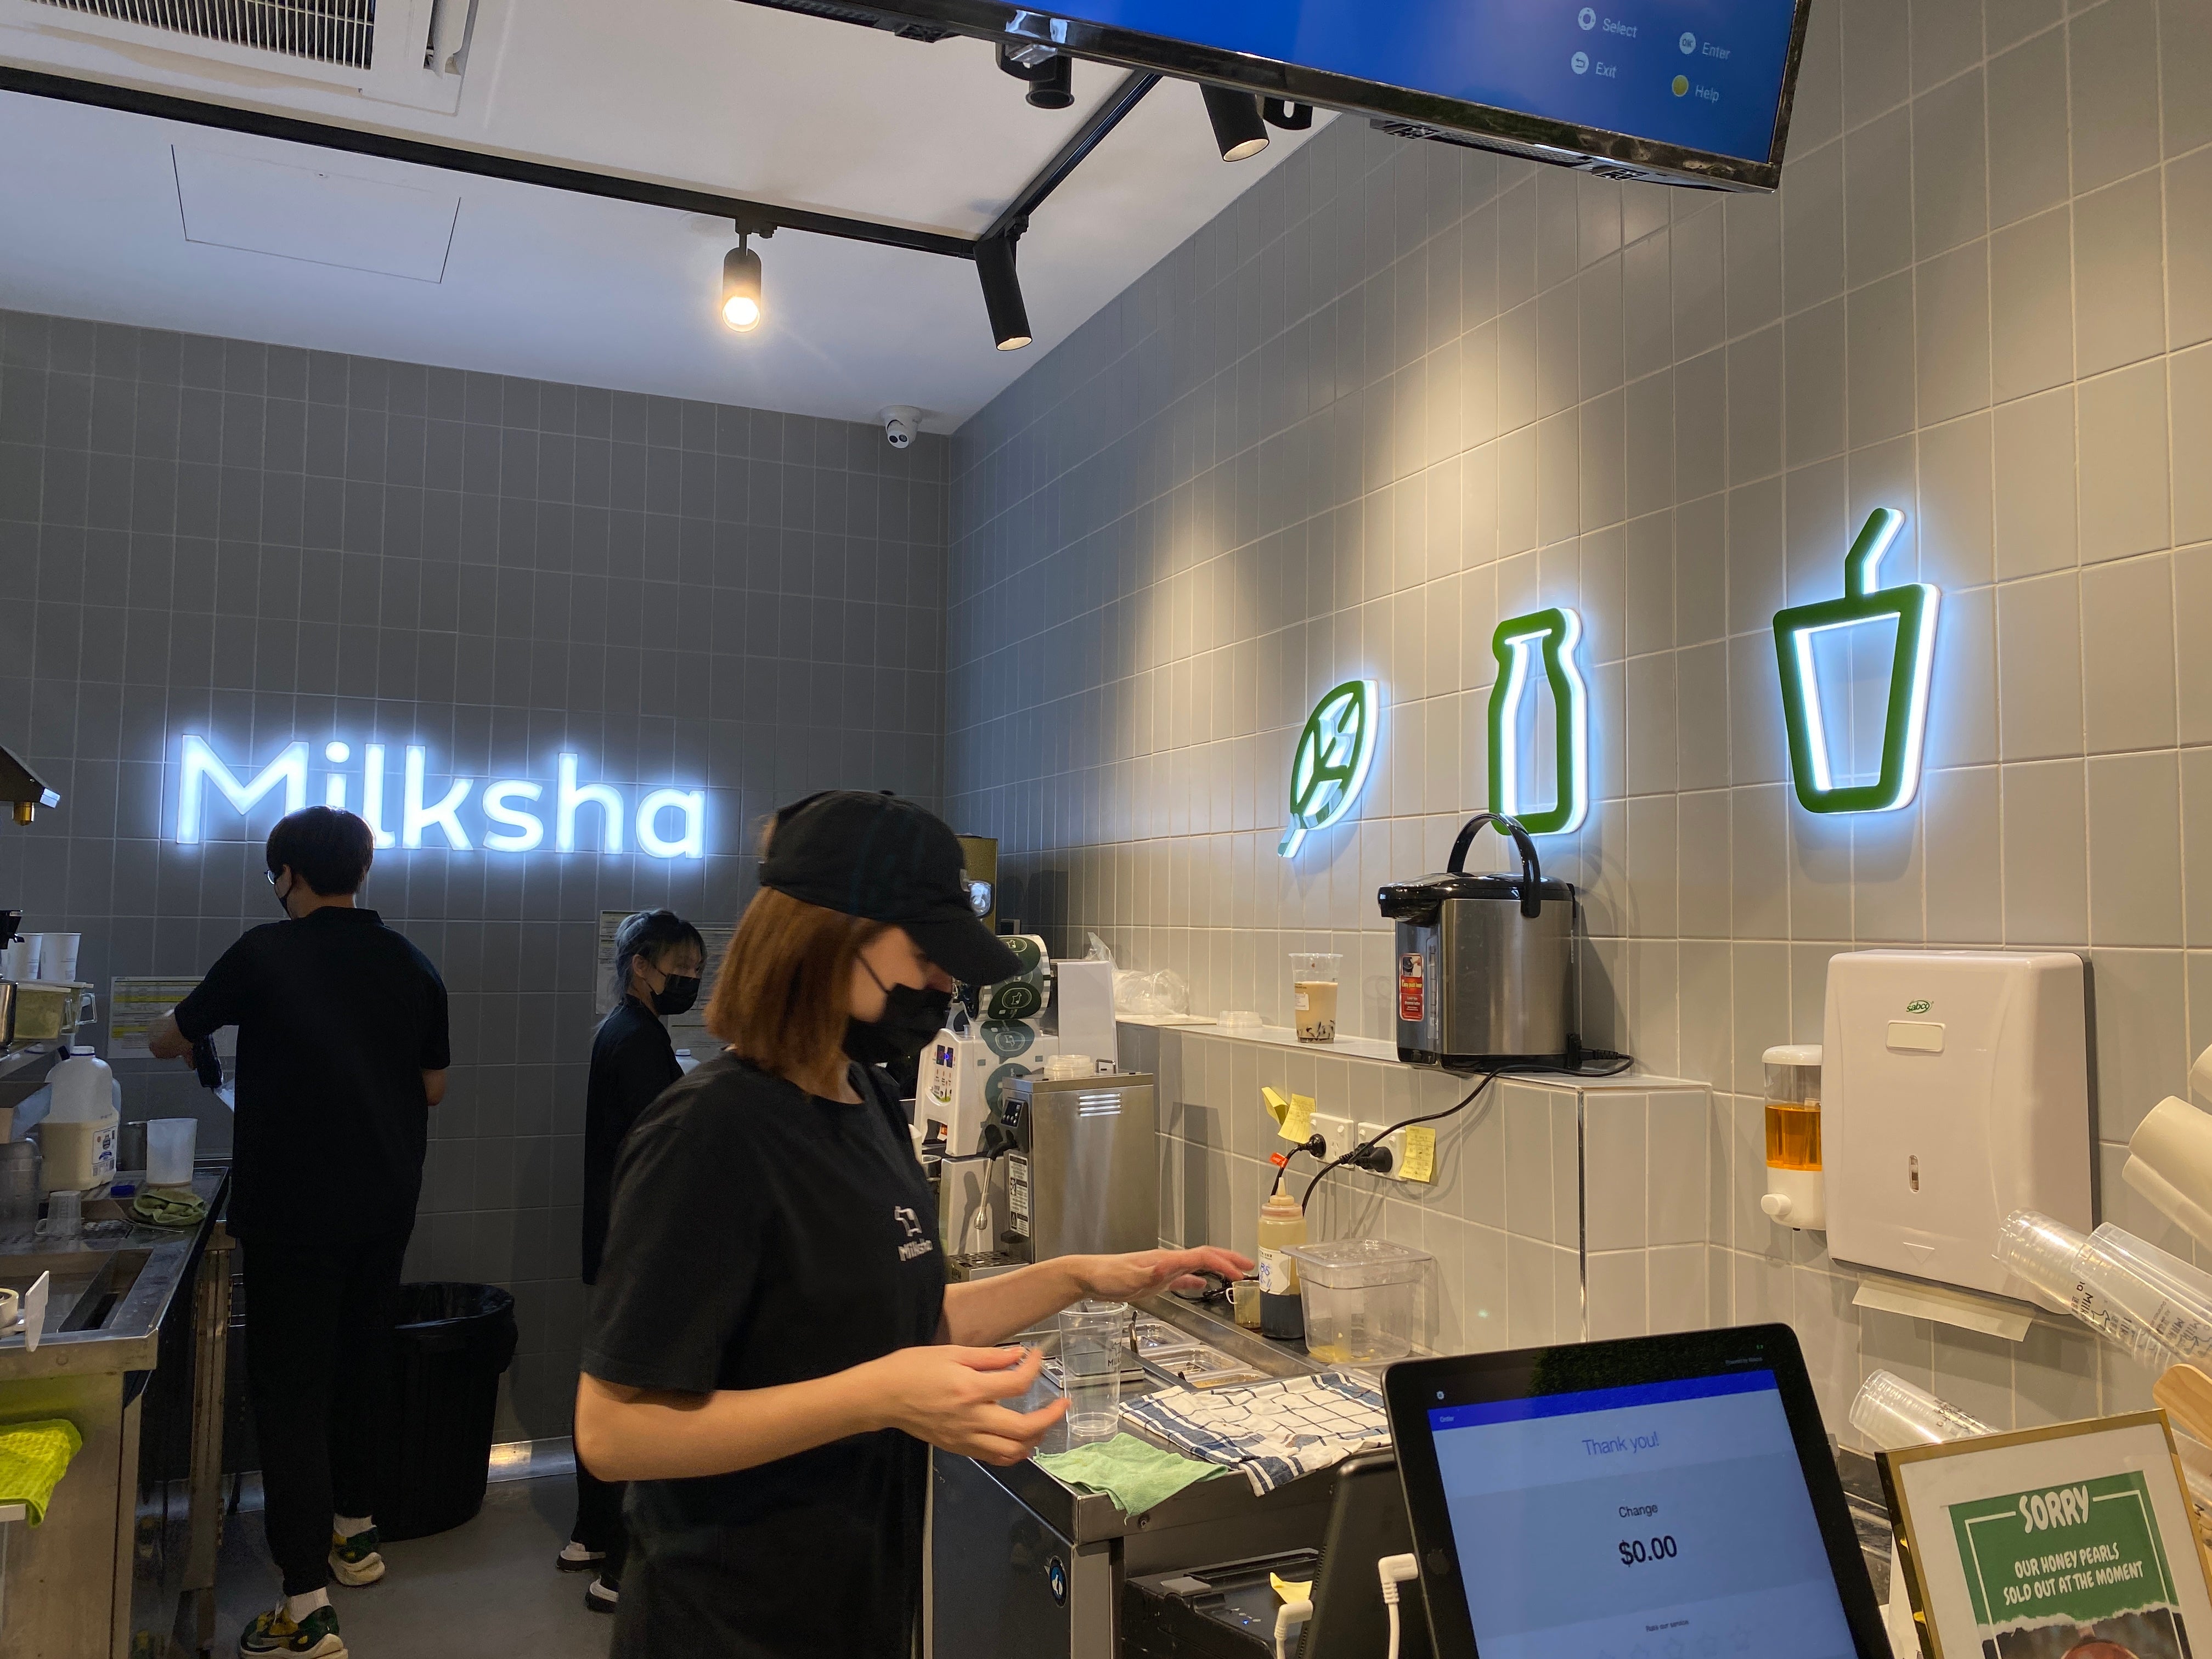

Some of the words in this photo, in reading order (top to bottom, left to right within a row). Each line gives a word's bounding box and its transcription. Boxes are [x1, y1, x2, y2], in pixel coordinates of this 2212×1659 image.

[1602, 18, 1638, 38] Select
[1702, 42, 1730, 60] Enter
[1595, 61, 1617, 78] Exit
[1695, 84, 1720, 103] Help
[176, 734, 705, 859] Milksha
[1906, 1001, 1930, 1013] sabco
[1582, 1436, 1628, 1455] Thank
[1630, 1431, 1660, 1453] you!
[1619, 1504, 1658, 1517] Change
[2019, 1485, 2089, 1533] SORRY
[1619, 1536, 1678, 1567] $0.00
[2015, 1558, 2040, 1579] OUR
[2040, 1550, 2077, 1573] HONEY
[2079, 1542, 2119, 1566] PEARLS
[2004, 1584, 2032, 1606] SOLD
[2034, 1578, 2056, 1599] OUT
[2059, 1575, 2073, 1594] AT
[2073, 1571, 2095, 1590] THE
[2096, 1561, 2143, 1585] MOMENT
